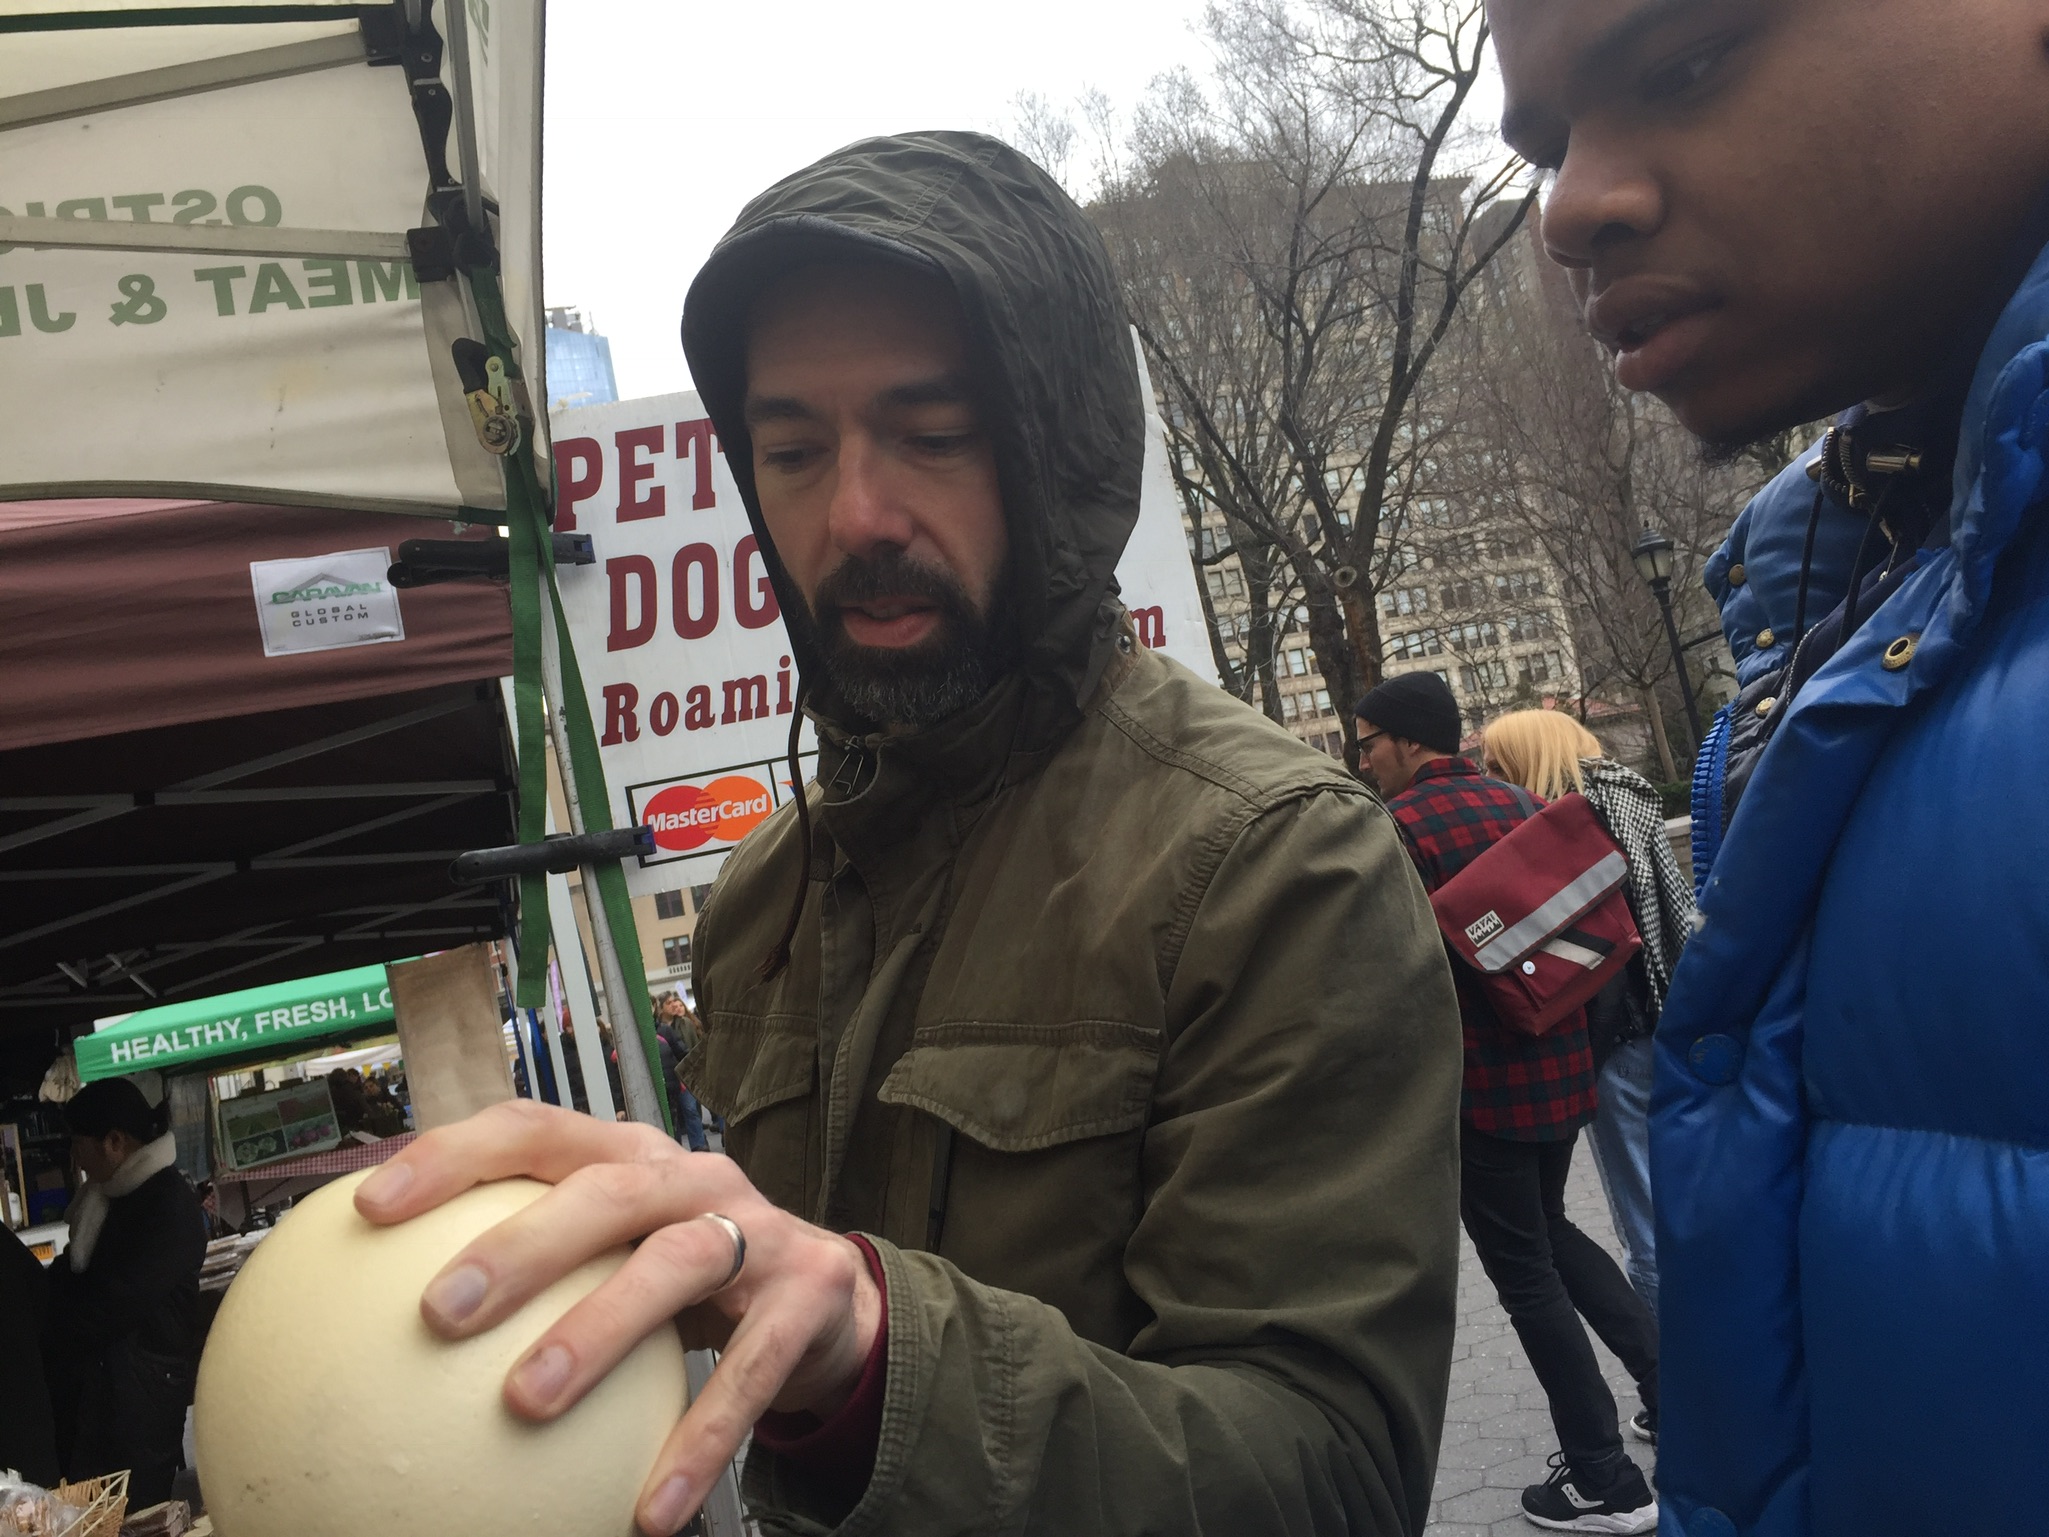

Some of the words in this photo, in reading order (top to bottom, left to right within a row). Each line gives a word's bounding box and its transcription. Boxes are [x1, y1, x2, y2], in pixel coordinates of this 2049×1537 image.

[552, 417, 723, 532] PET
[291, 604, 367, 618] GLOBAL
[292, 612, 369, 627] CUSTOM
[605, 533, 781, 653] DOG
[600, 654, 793, 747] Roami
[648, 793, 768, 832] MasterCard
[110, 1017, 248, 1063] HEALTHY,
[254, 997, 356, 1034] FRESH,
